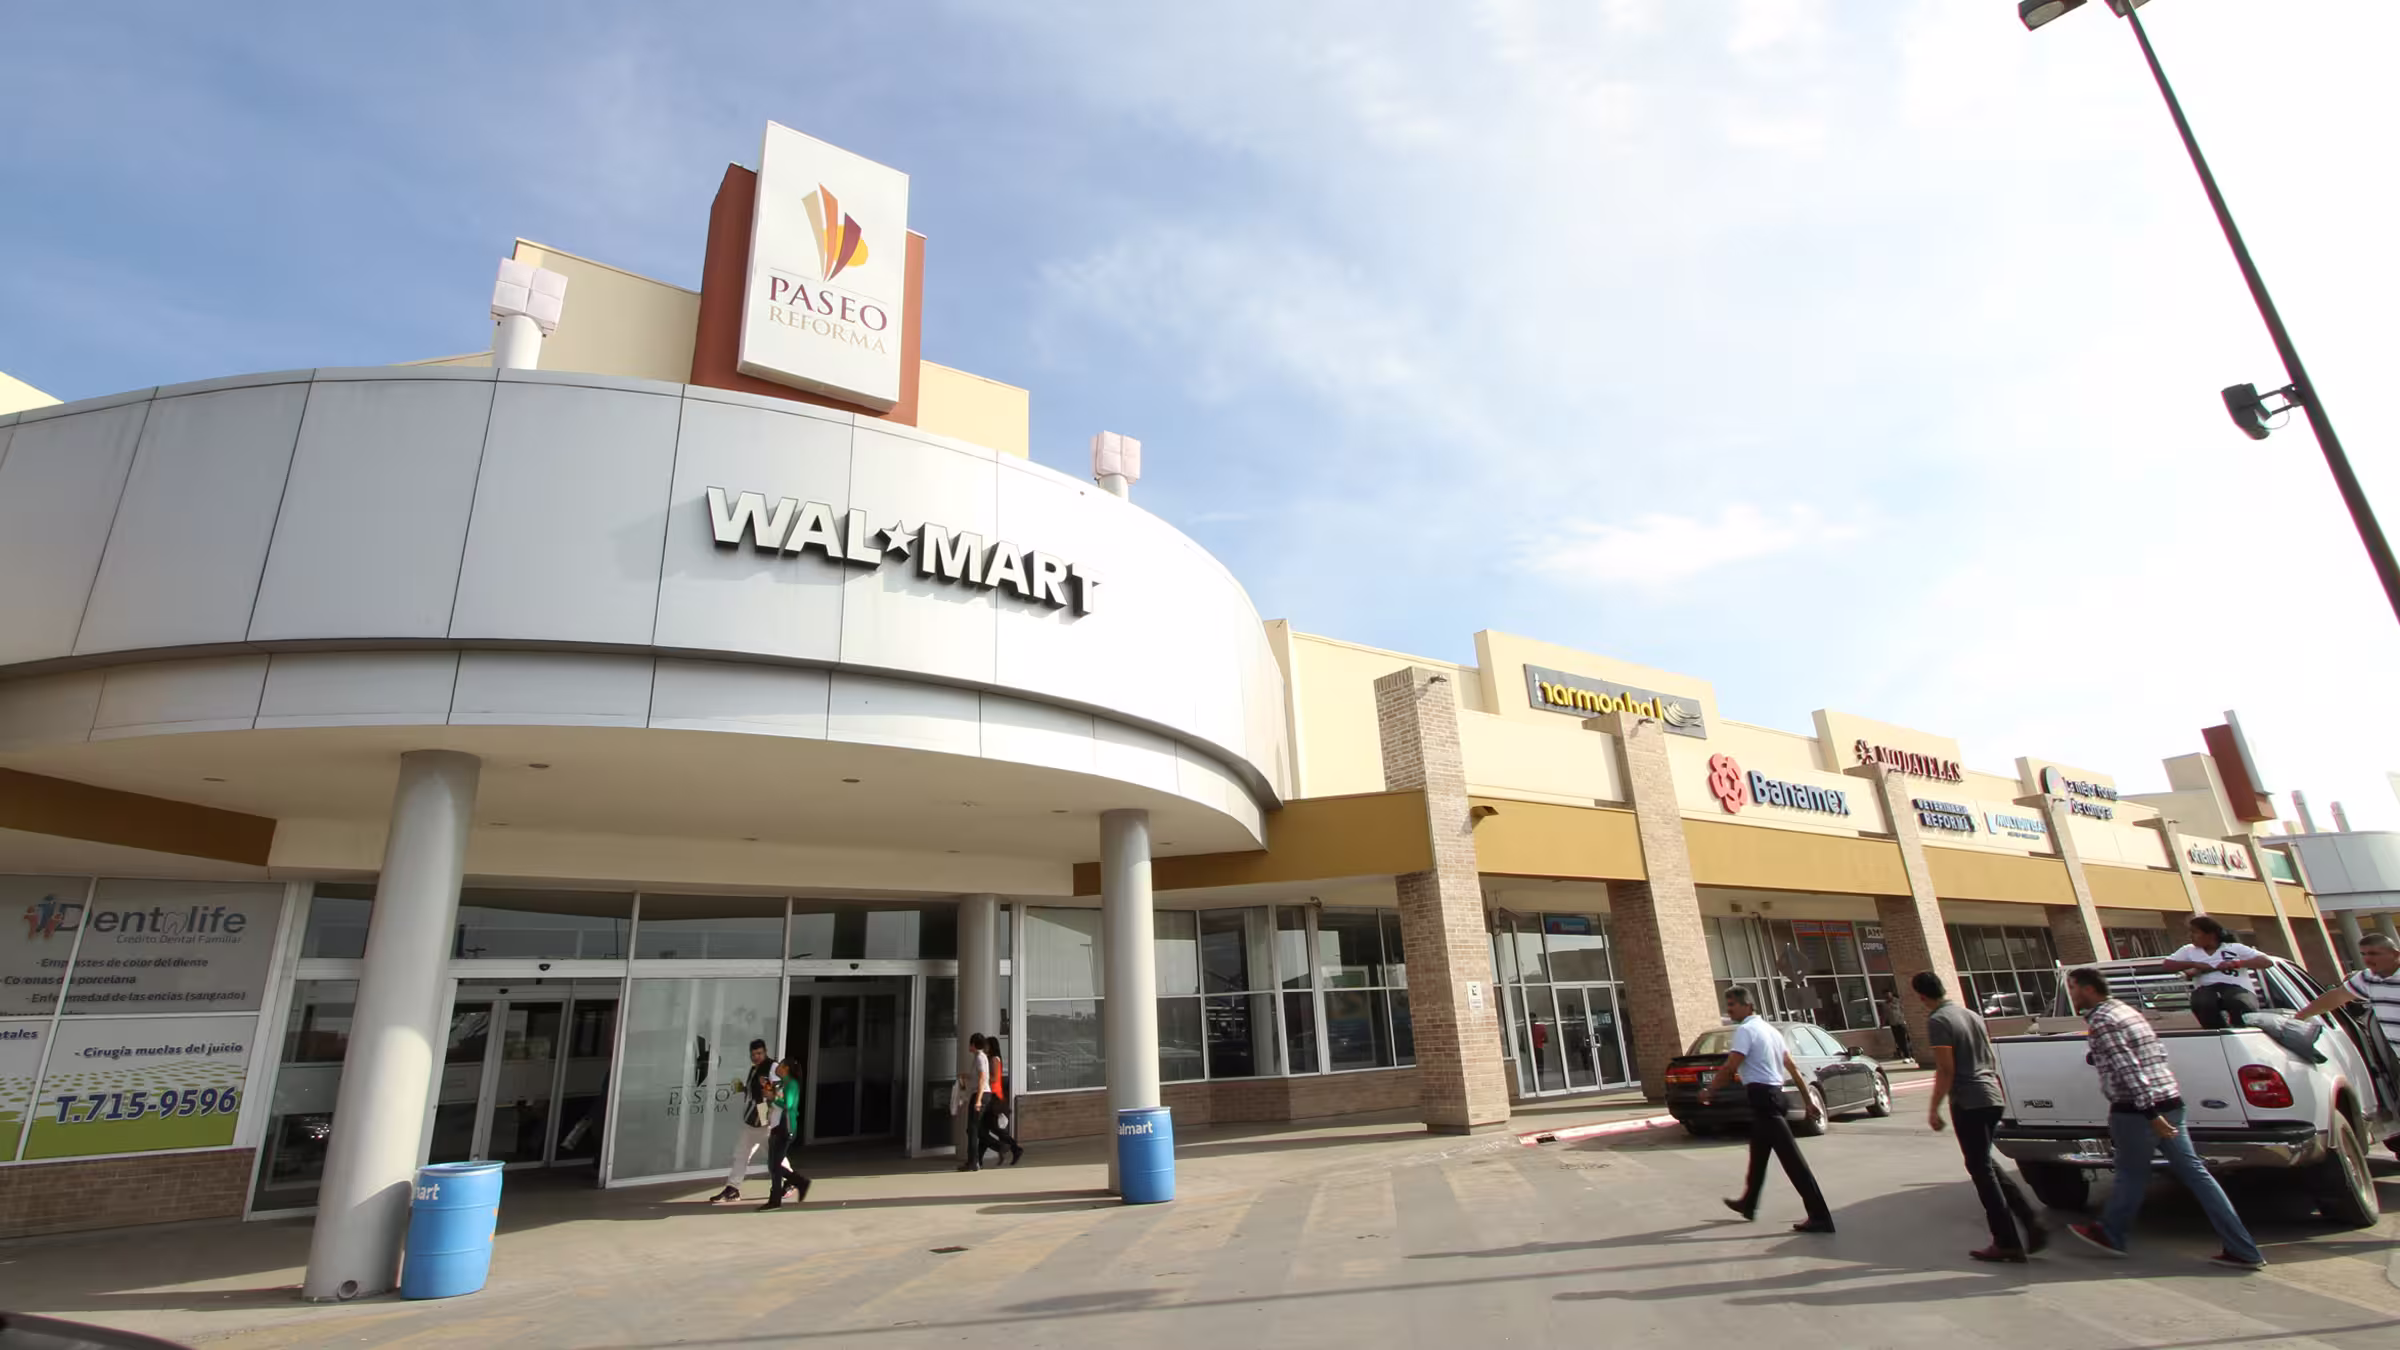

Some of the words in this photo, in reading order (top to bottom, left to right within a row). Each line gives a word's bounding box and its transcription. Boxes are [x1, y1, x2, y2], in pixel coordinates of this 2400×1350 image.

[768, 275, 888, 331] PASEO
[768, 304, 887, 355] REFORMA
[1874, 745, 1963, 784] MODATELAS
[1747, 769, 1850, 816] Banamex
[1919, 812, 1974, 832] REFORMA
[159, 934, 196, 944] Dental
[198, 934, 242, 944] Familiar
[106, 957, 121, 968] de
[122, 958, 152, 968] color
[172, 957, 209, 968] diente
[77, 975, 137, 987] porcelana
[111, 993, 127, 1002] de
[128, 992, 146, 1001] las
[135, 1044, 181, 1056] muelas
[185, 1043, 206, 1055] del
[206, 1042, 244, 1056] juicio
[56, 1086, 237, 1125] T.715-9596
